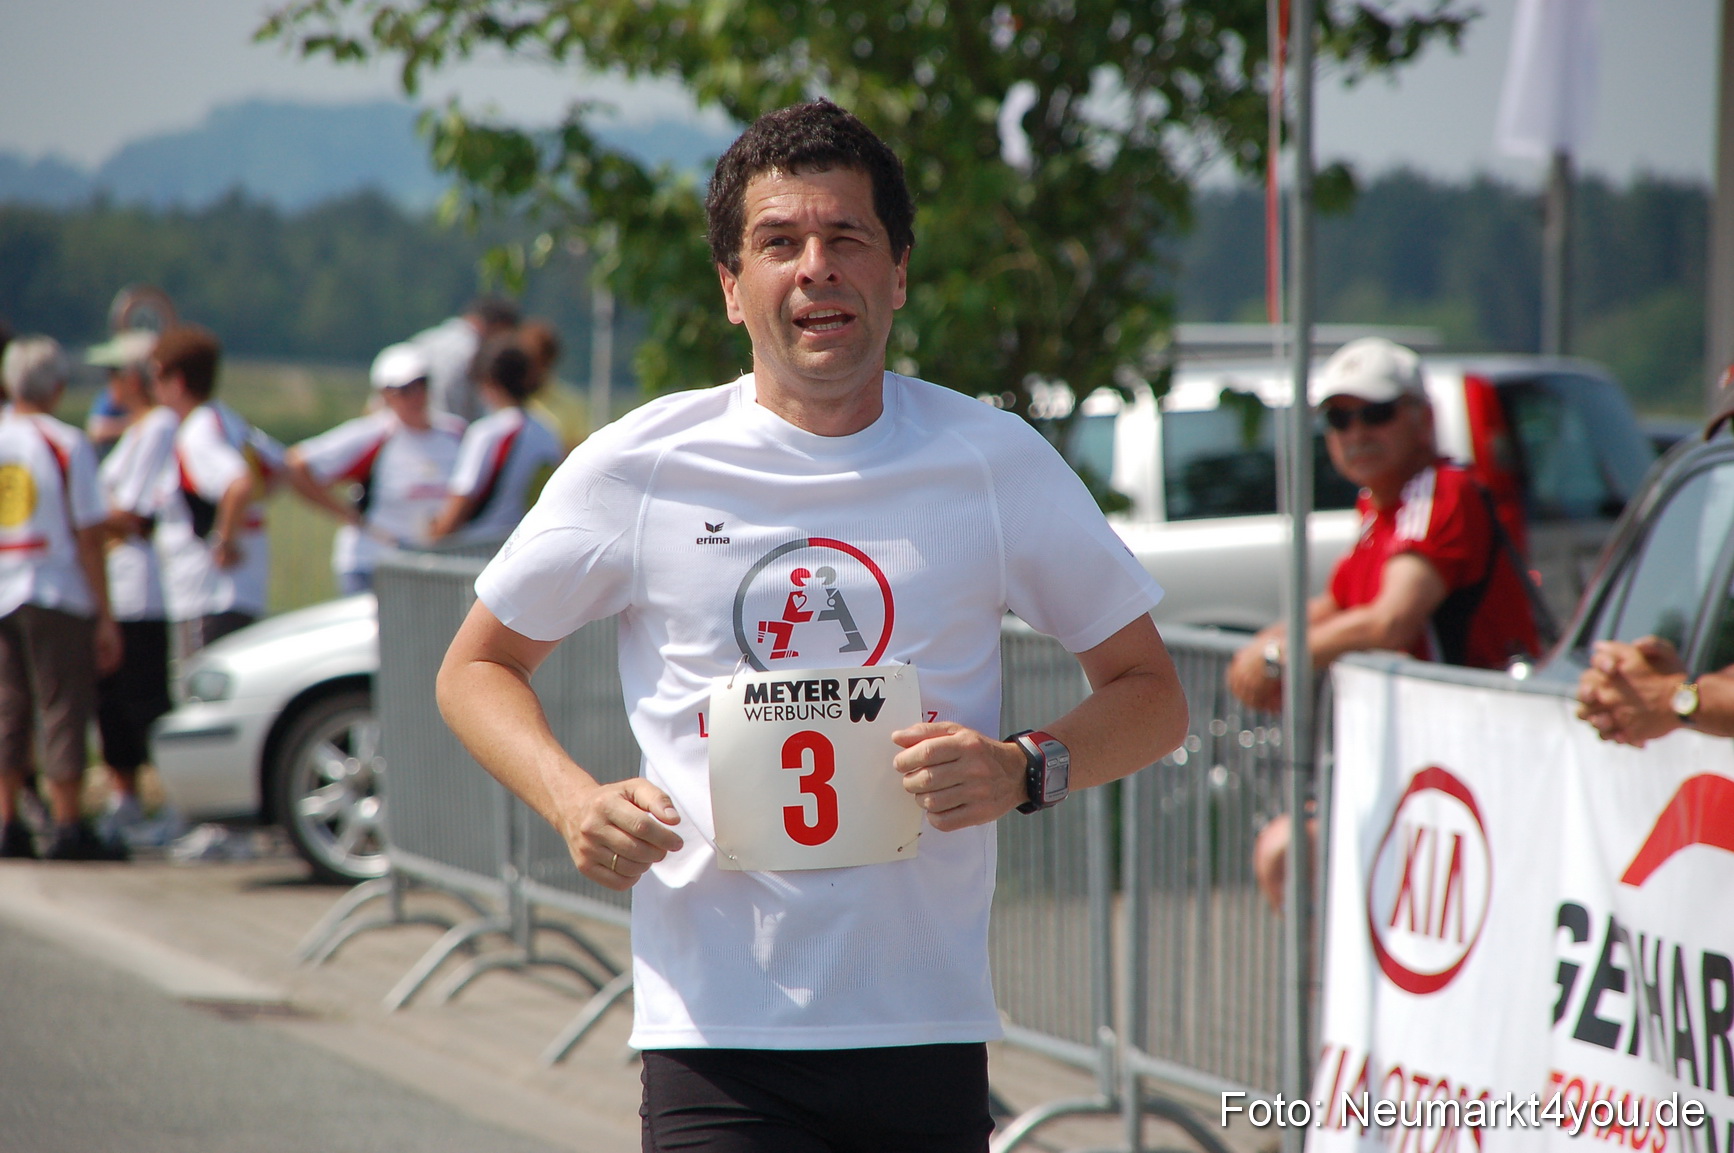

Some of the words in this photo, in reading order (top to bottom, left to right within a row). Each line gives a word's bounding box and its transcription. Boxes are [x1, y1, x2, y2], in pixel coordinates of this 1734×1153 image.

[696, 535, 730, 546] erima
[743, 679, 842, 706] MEYER
[743, 702, 843, 723] WERBUNG
[780, 730, 840, 846] 3
[1388, 824, 1466, 943] KIA
